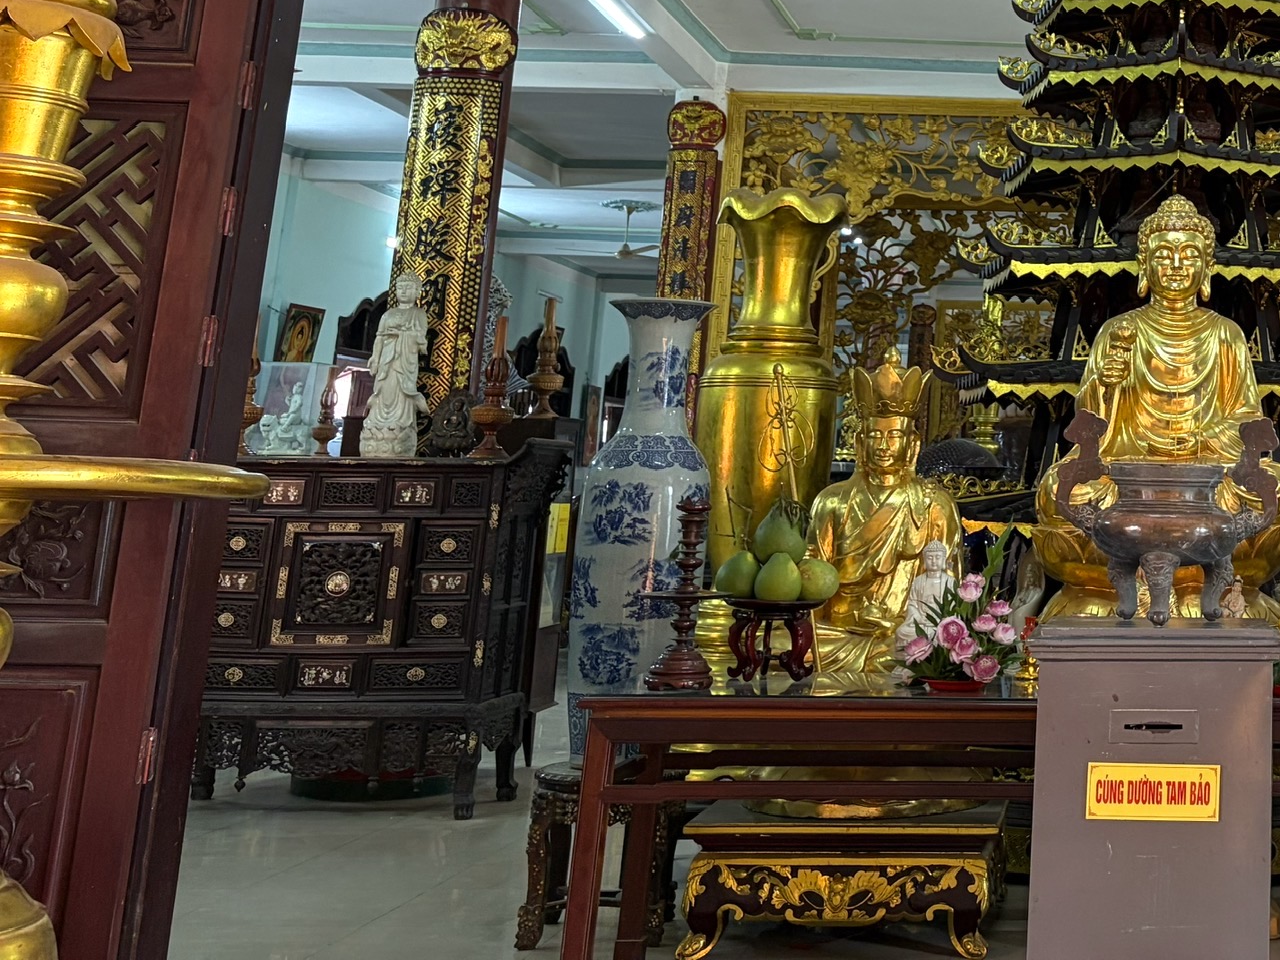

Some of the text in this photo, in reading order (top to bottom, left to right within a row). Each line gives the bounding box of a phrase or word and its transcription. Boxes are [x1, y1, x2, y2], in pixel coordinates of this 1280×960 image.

[1096, 773, 1211, 806] CÚNG DƯỜNG TAM BẢO
